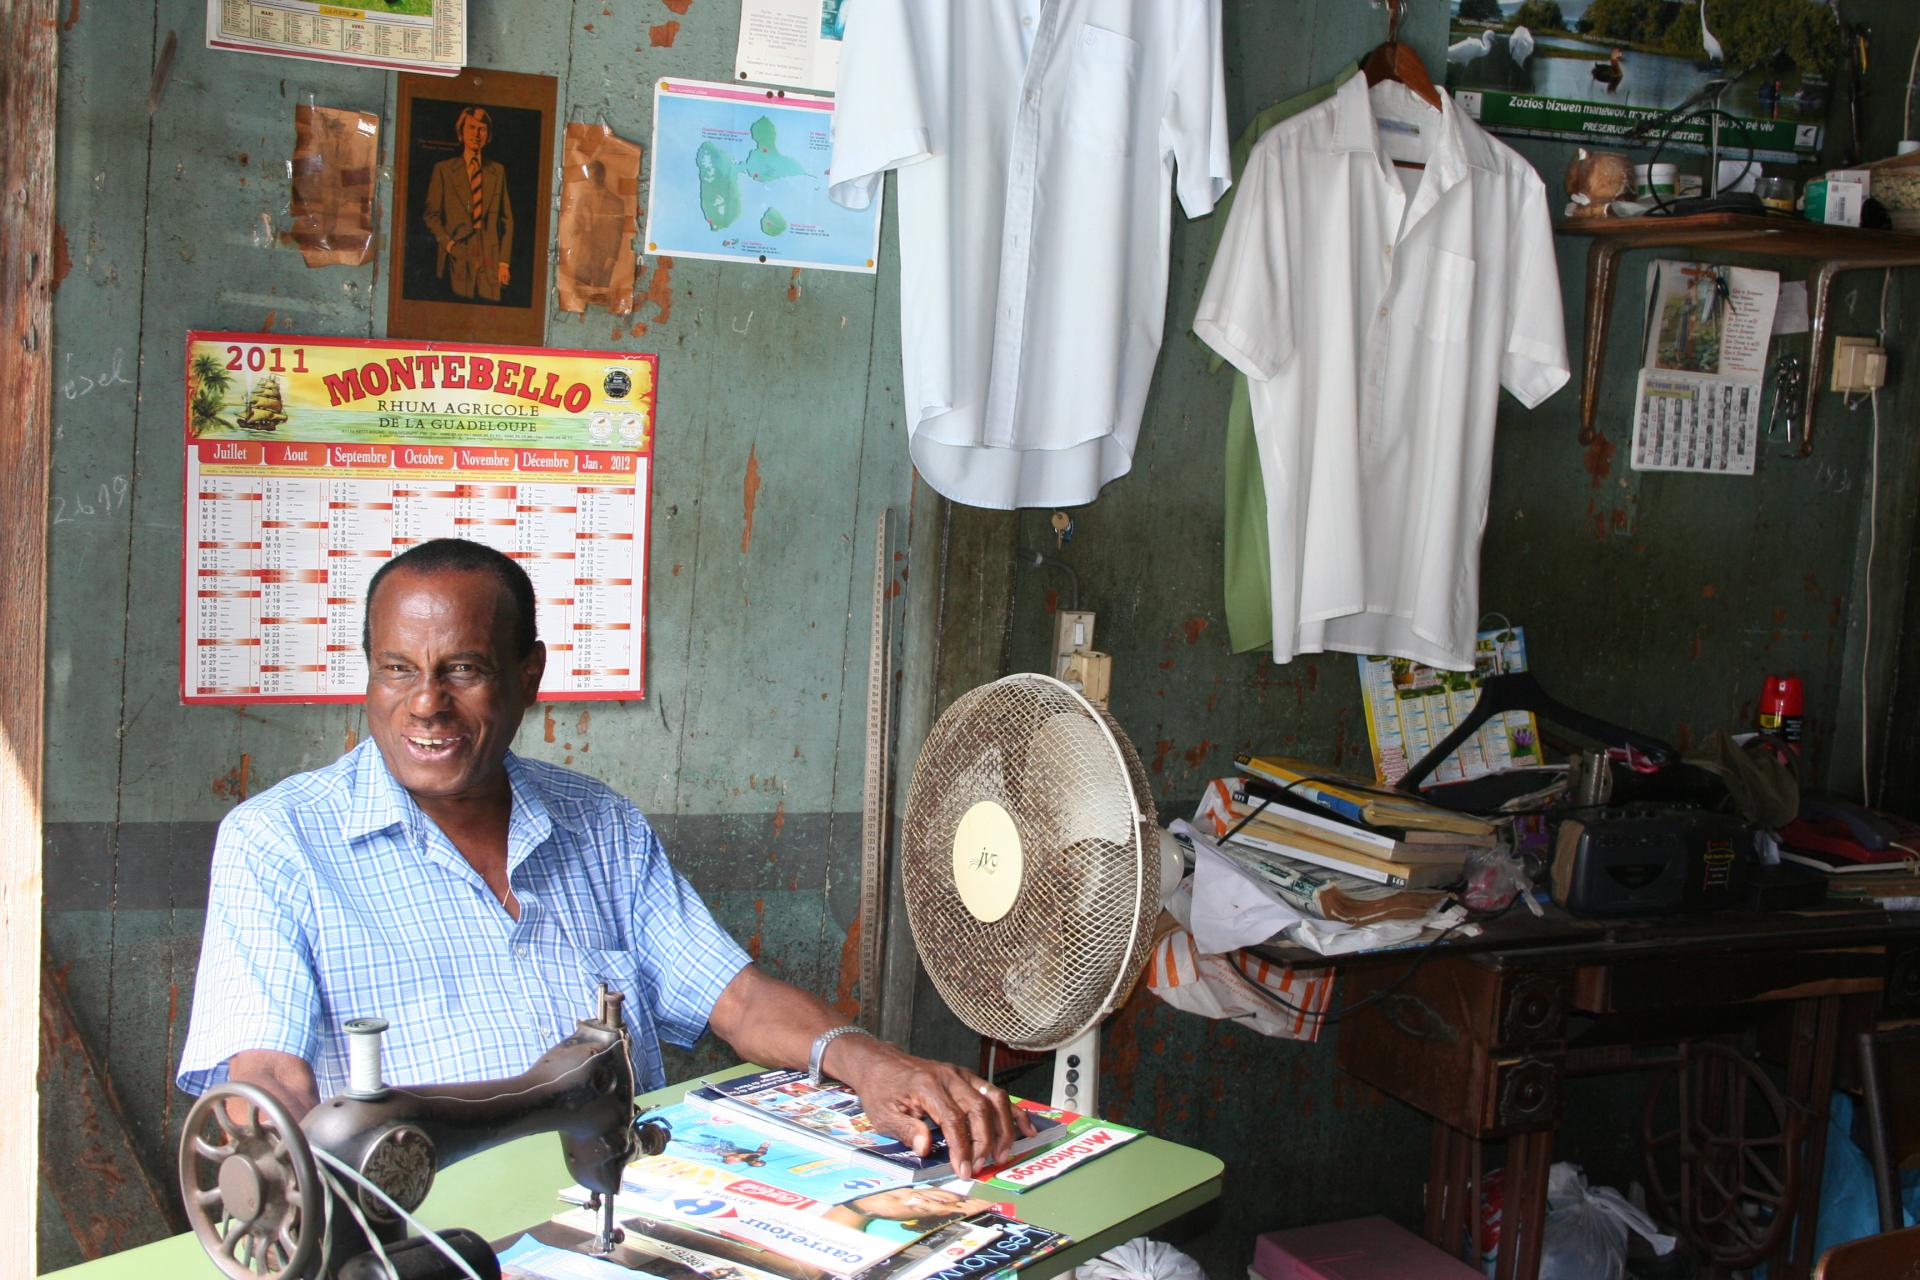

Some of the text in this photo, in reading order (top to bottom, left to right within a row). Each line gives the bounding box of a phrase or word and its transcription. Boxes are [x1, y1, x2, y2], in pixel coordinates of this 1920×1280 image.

[1509, 96, 1544, 110] Zozios
[1545, 100, 1581, 113] bizwen
[225, 345, 309, 373] 2011
[322, 355, 592, 413] MONTEBELLO
[377, 400, 540, 417] RHUM AGRICOLE
[379, 417, 537, 433] DE LA GUADELOUPE
[213, 443, 248, 461] Juillet
[284, 448, 308, 462] Aout
[334, 447, 387, 466] Septembre
[404, 448, 444, 464] Octobre
[461, 450, 509, 466] Novembre
[522, 451, 569, 468] Décembre
[610, 455, 631, 471] 2012
[739, 1217, 863, 1263] Carrefour
